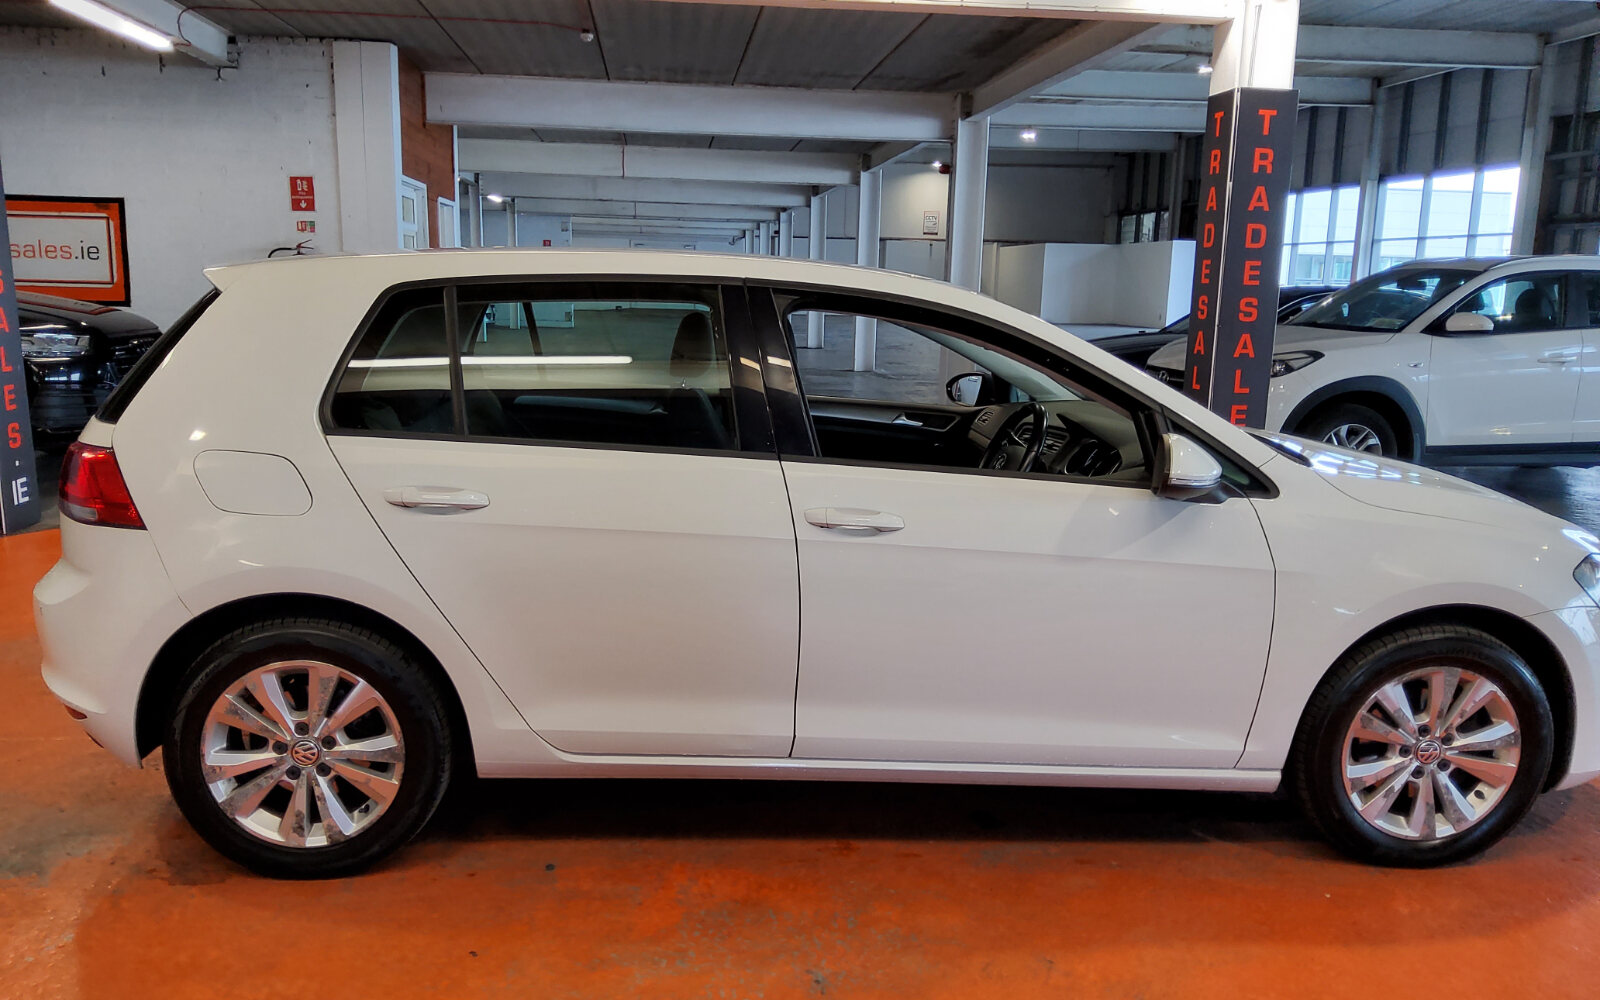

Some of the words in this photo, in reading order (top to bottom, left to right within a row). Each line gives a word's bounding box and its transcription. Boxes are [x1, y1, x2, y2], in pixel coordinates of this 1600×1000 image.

[10, 239, 100, 260] sales.ie
[1192, 111, 1224, 390] TRADESAL
[1230, 109, 1278, 427] TRADESALE
